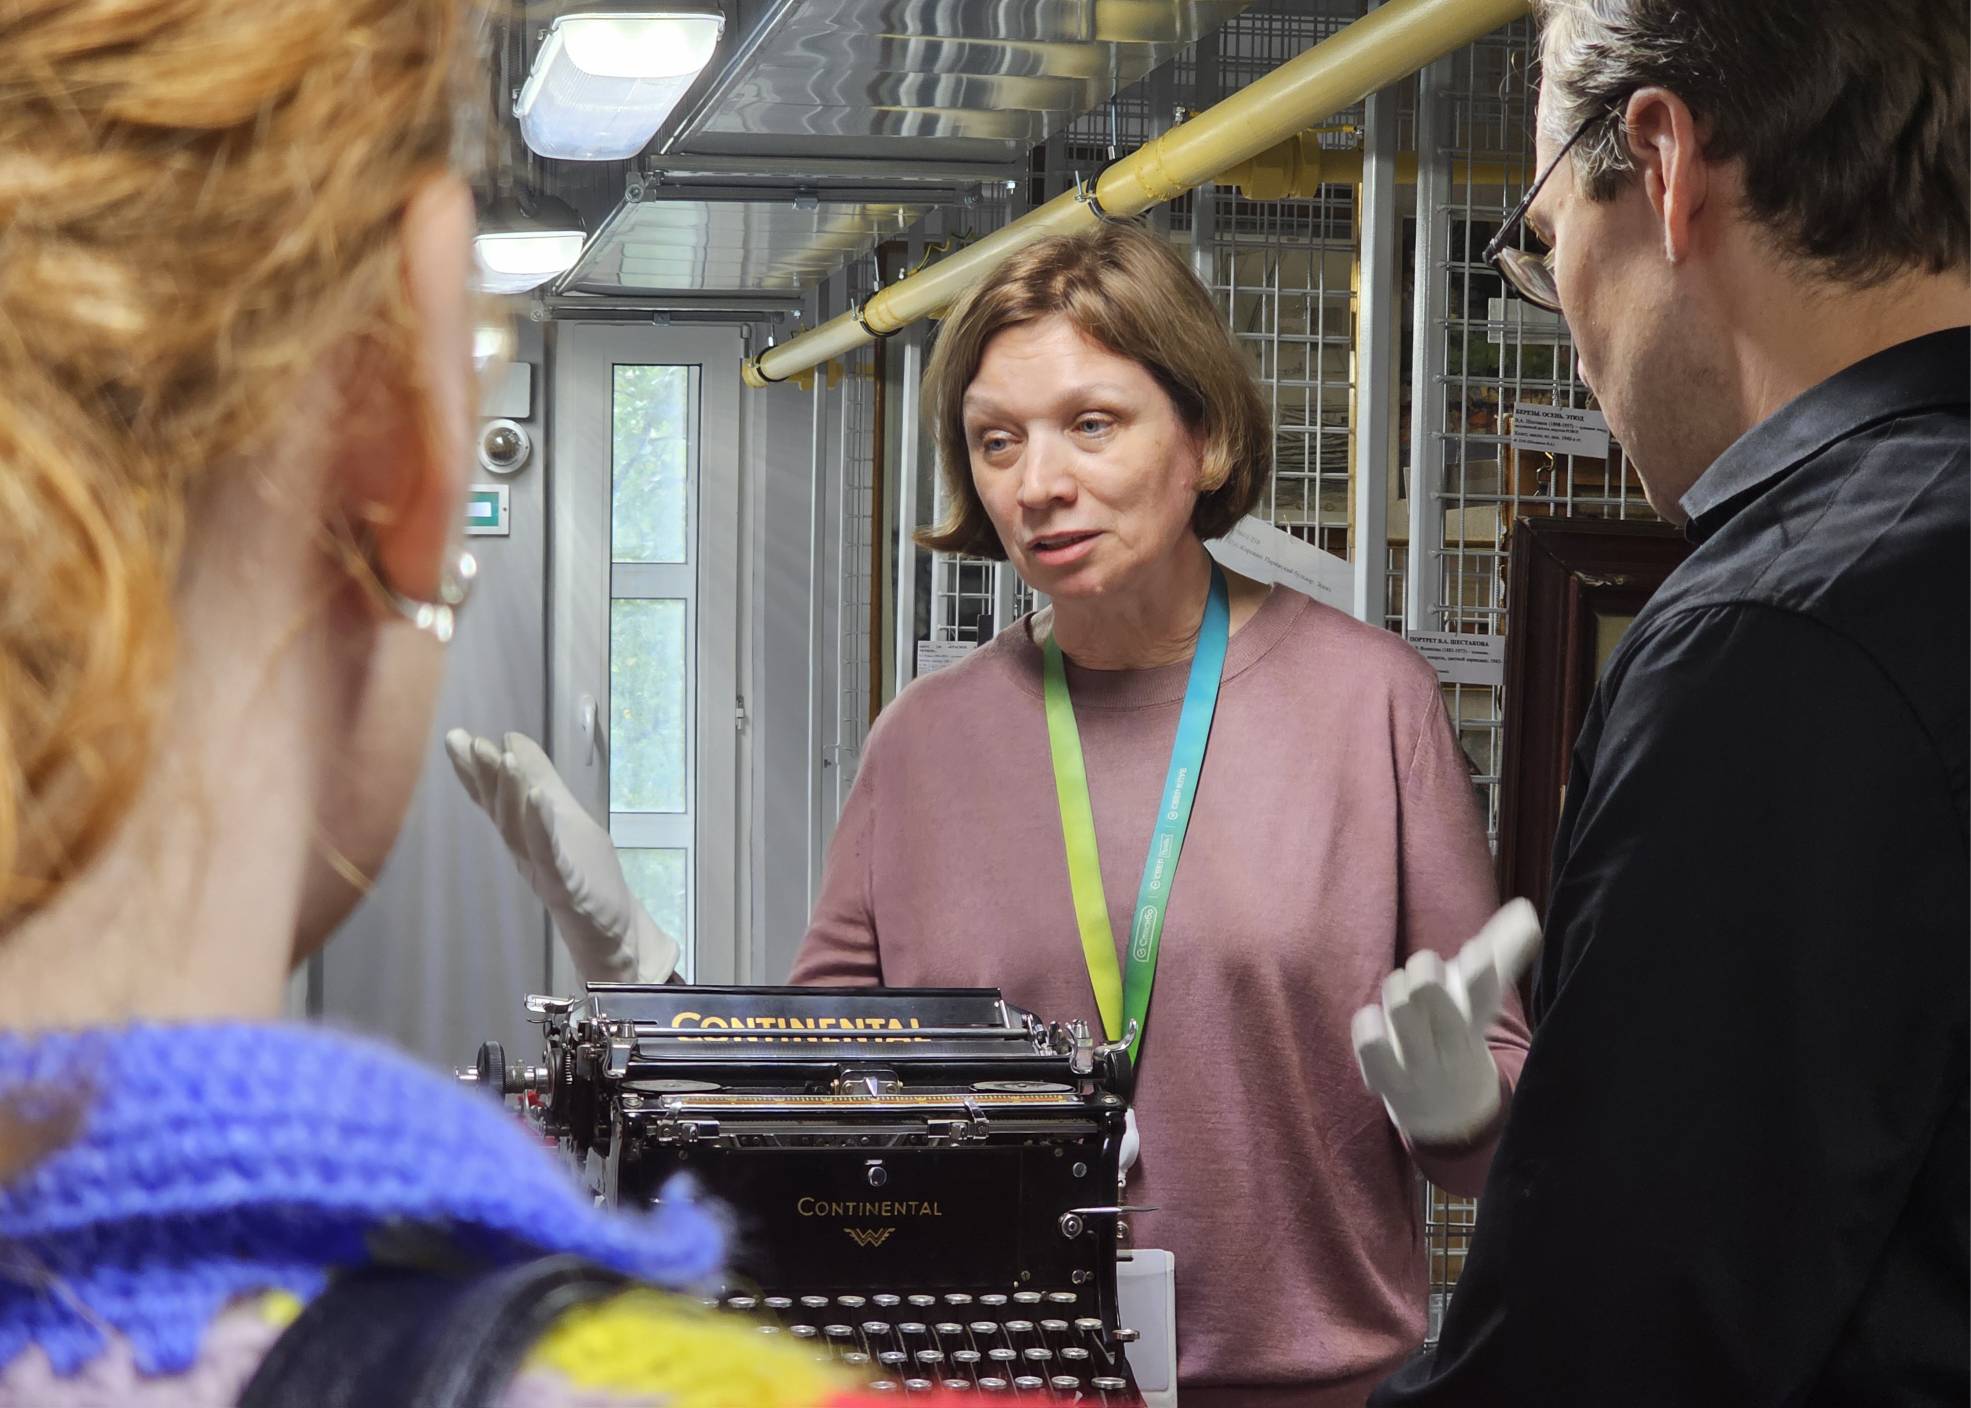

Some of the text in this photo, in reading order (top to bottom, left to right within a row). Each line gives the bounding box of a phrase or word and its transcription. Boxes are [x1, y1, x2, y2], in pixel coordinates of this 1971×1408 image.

[1409, 636, 1437, 644] ПОРТРЕТ
[1450, 639, 1489, 647] ШЕСТАКОВА
[671, 1011, 932, 1043] CONTINENTAL
[797, 1196, 943, 1217] CONTINENTAL
